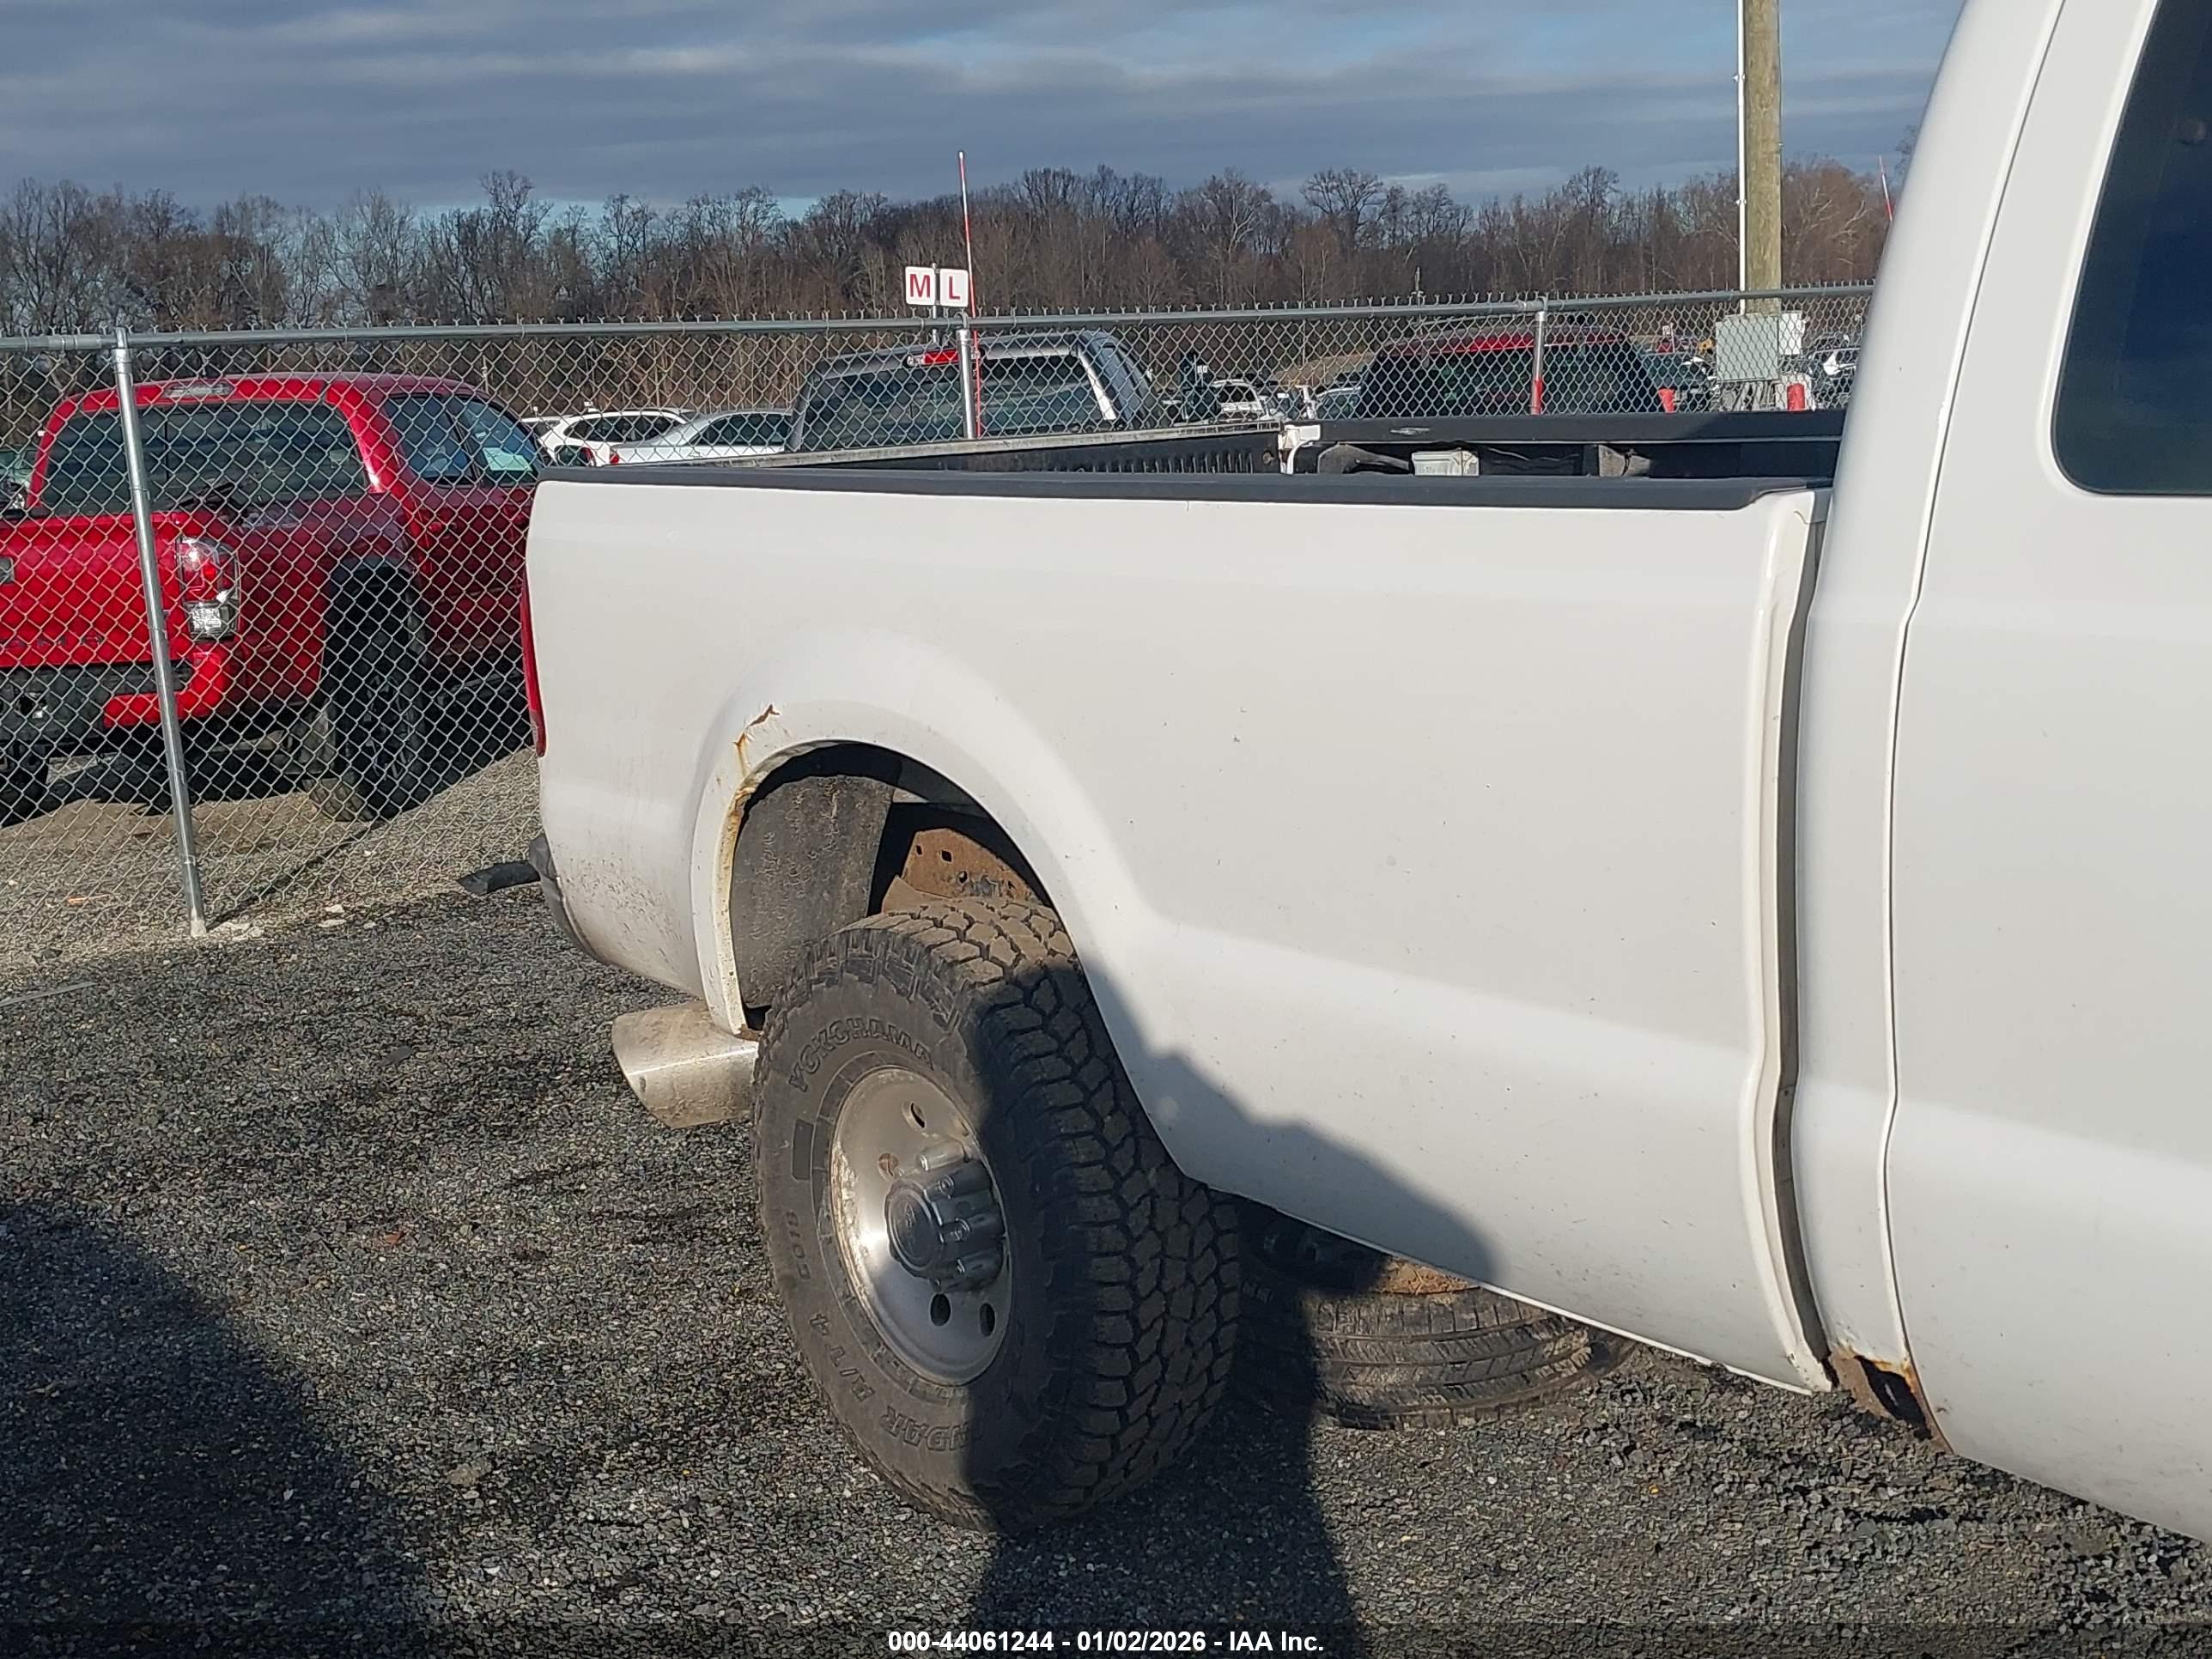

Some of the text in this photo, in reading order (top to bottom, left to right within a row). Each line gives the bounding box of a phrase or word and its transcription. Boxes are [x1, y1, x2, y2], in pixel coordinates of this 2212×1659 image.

[909, 274, 931, 298] M
[948, 276, 961, 300] L
[787, 1017, 934, 1093] YOKOHAMA
[879, 1406, 970, 1451] NDAR
